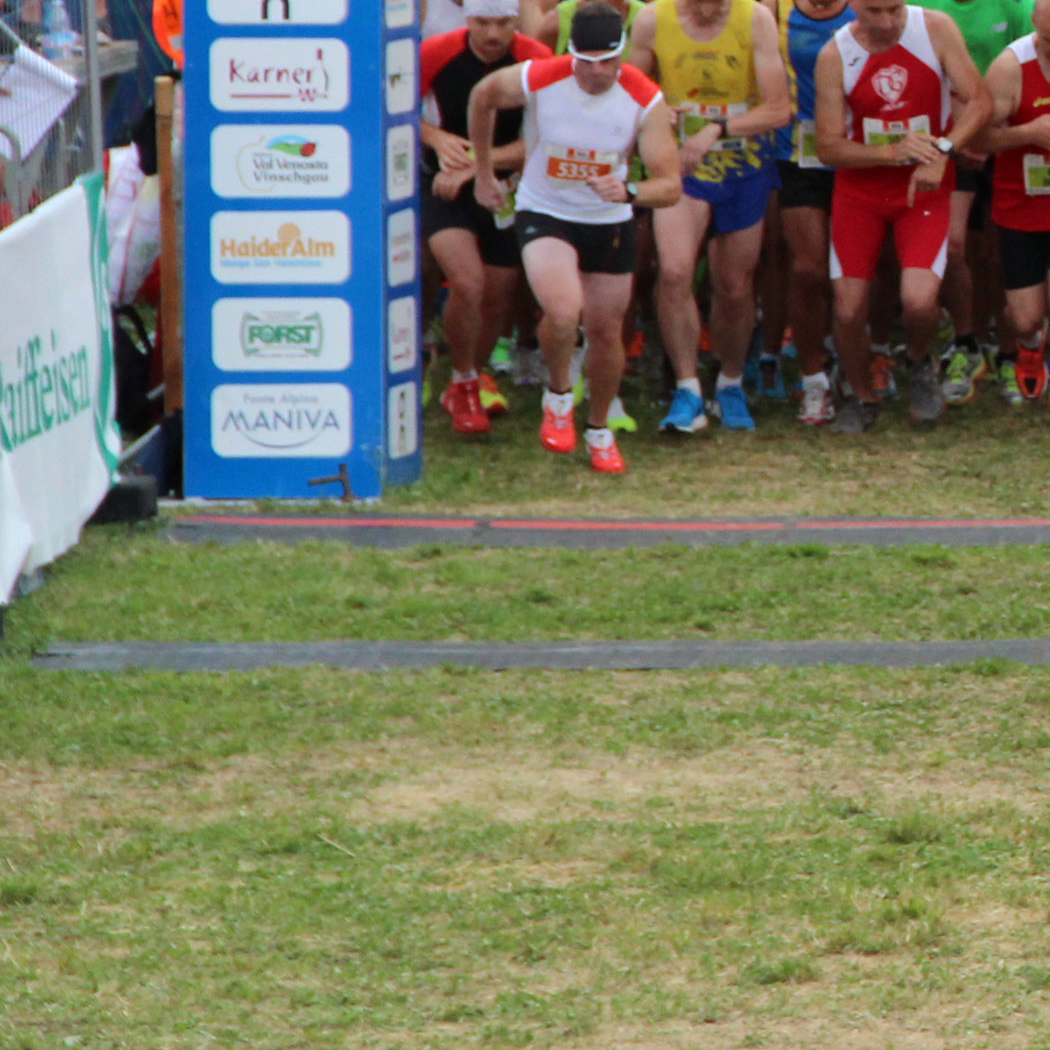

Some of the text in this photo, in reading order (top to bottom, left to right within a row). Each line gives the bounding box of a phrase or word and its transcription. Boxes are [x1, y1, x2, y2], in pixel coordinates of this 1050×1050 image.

[229, 58, 314, 84] Karner
[252, 171, 330, 186] Vinschgau
[221, 409, 341, 431] MANIVA
